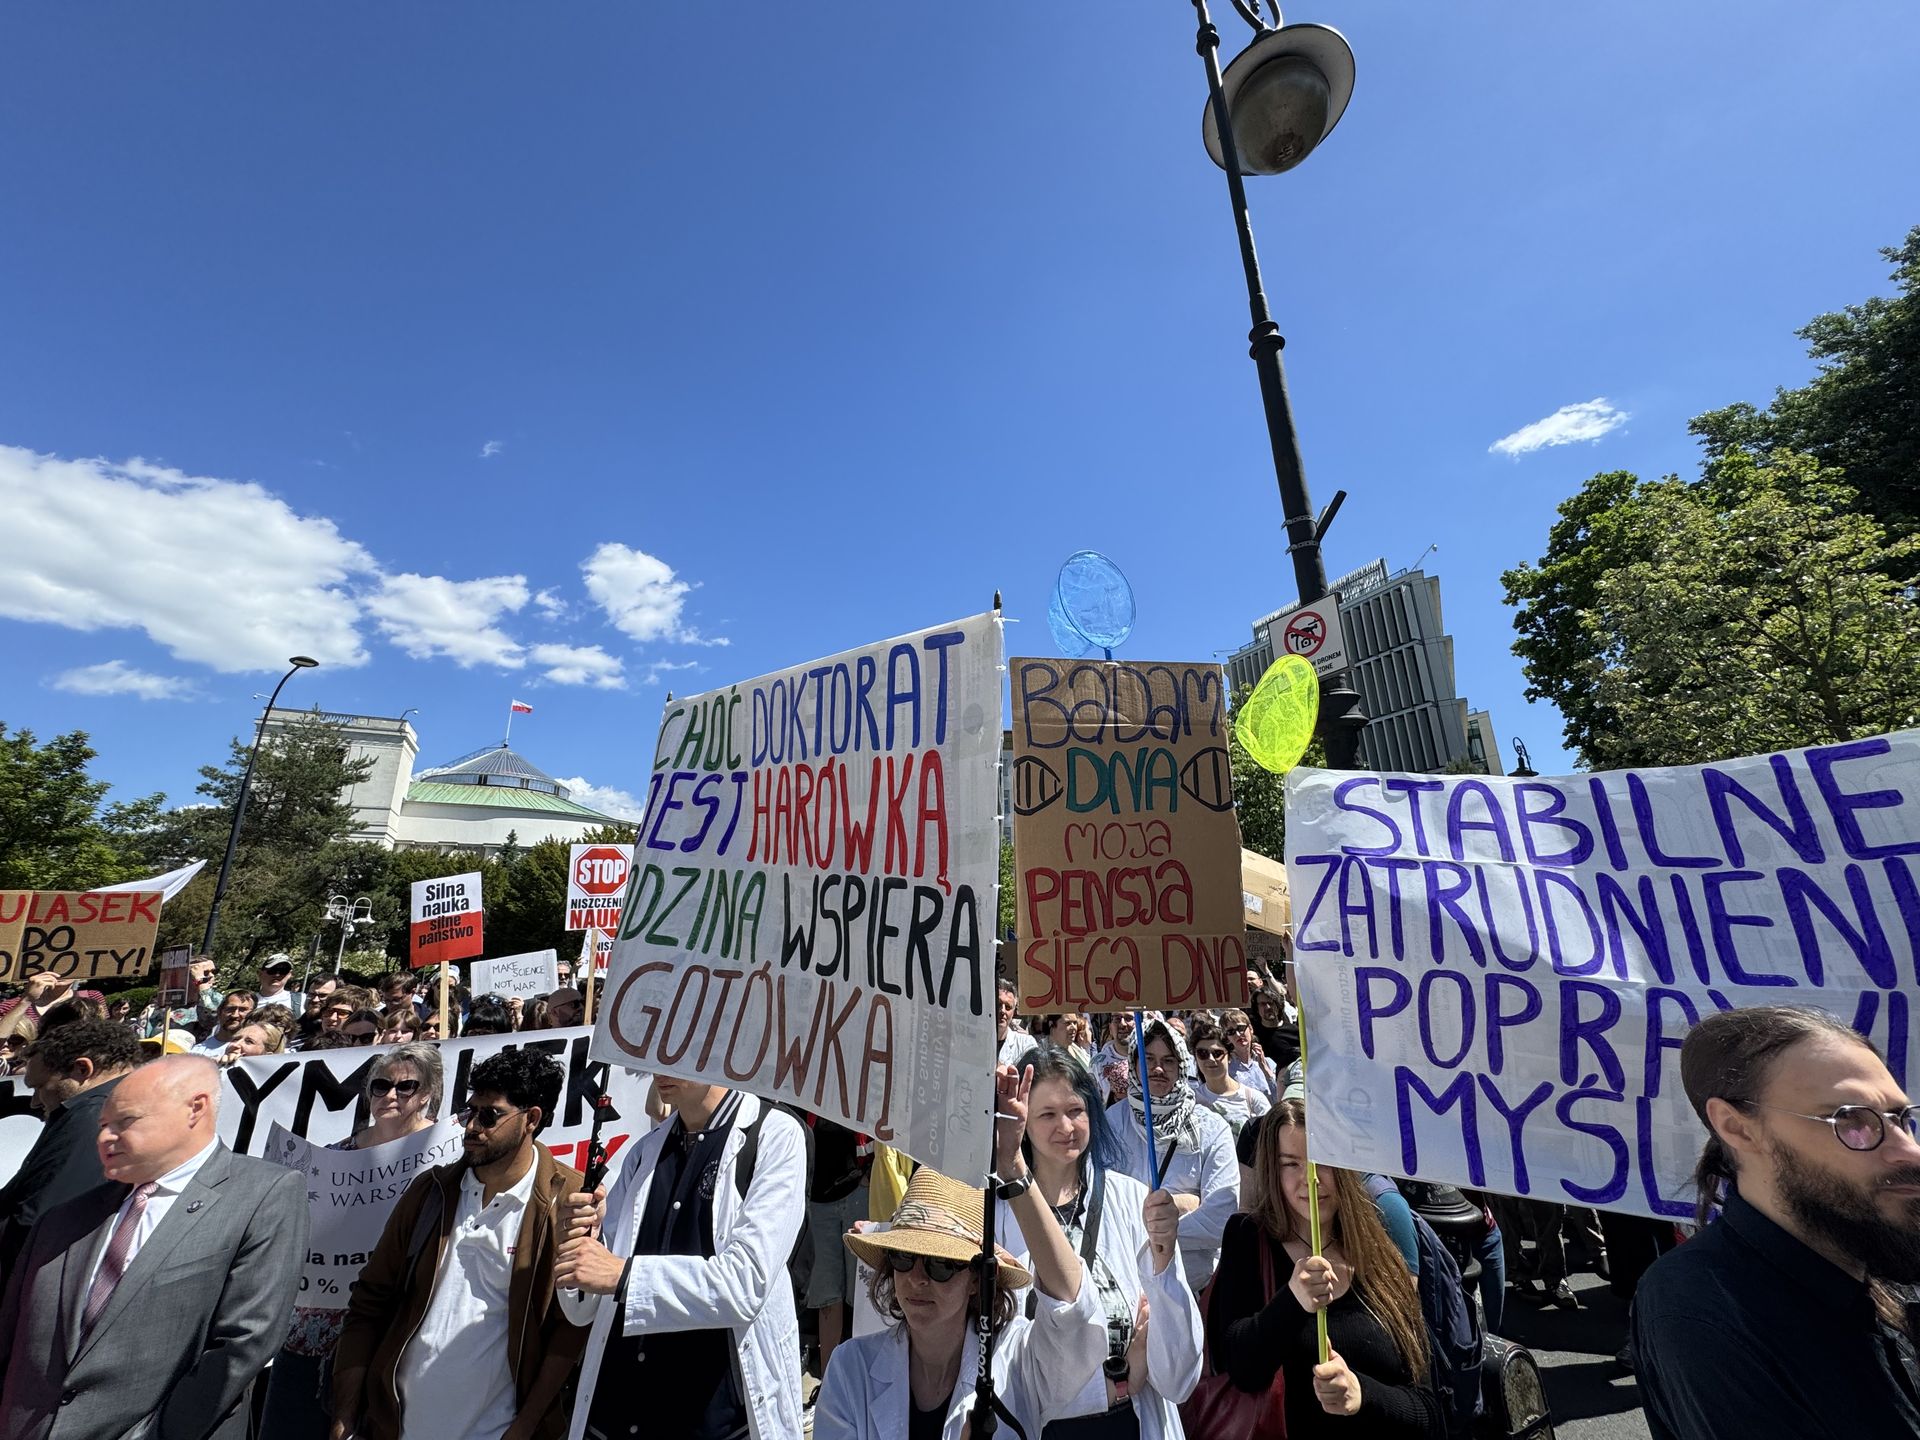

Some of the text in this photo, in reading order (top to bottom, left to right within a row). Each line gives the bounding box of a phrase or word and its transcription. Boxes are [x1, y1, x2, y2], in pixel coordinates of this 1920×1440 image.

[1317, 651, 1341, 665] DRONEM
[1318, 663, 1333, 674] ZONE
[655, 685, 741, 771] CHOĆ
[752, 631, 965, 767] DOKTORAT
[1066, 747, 1178, 814] DNA
[1334, 738, 1920, 870] STABILNE
[634, 771, 748, 856] JEST
[747, 749, 952, 896] HARÓWKĄ
[579, 858, 626, 884] STOP
[426, 882, 465, 902] Silna
[571, 898, 625, 909] NISZCZENI
[423, 897, 470, 918] nauka
[570, 908, 622, 929] NAUK
[430, 914, 461, 931] silne
[22, 925, 76, 952] DO
[780, 872, 983, 1016] WSPIERA
[492, 961, 545, 978] MAKE SCIENCE
[1162, 933, 1249, 1005] DNA
[494, 979, 536, 992] NOT WAR
[609, 960, 895, 1141] GOTÓWKĄ
[1395, 1066, 1700, 1217] MYŚL
[330, 1177, 412, 1208] WARSZ
